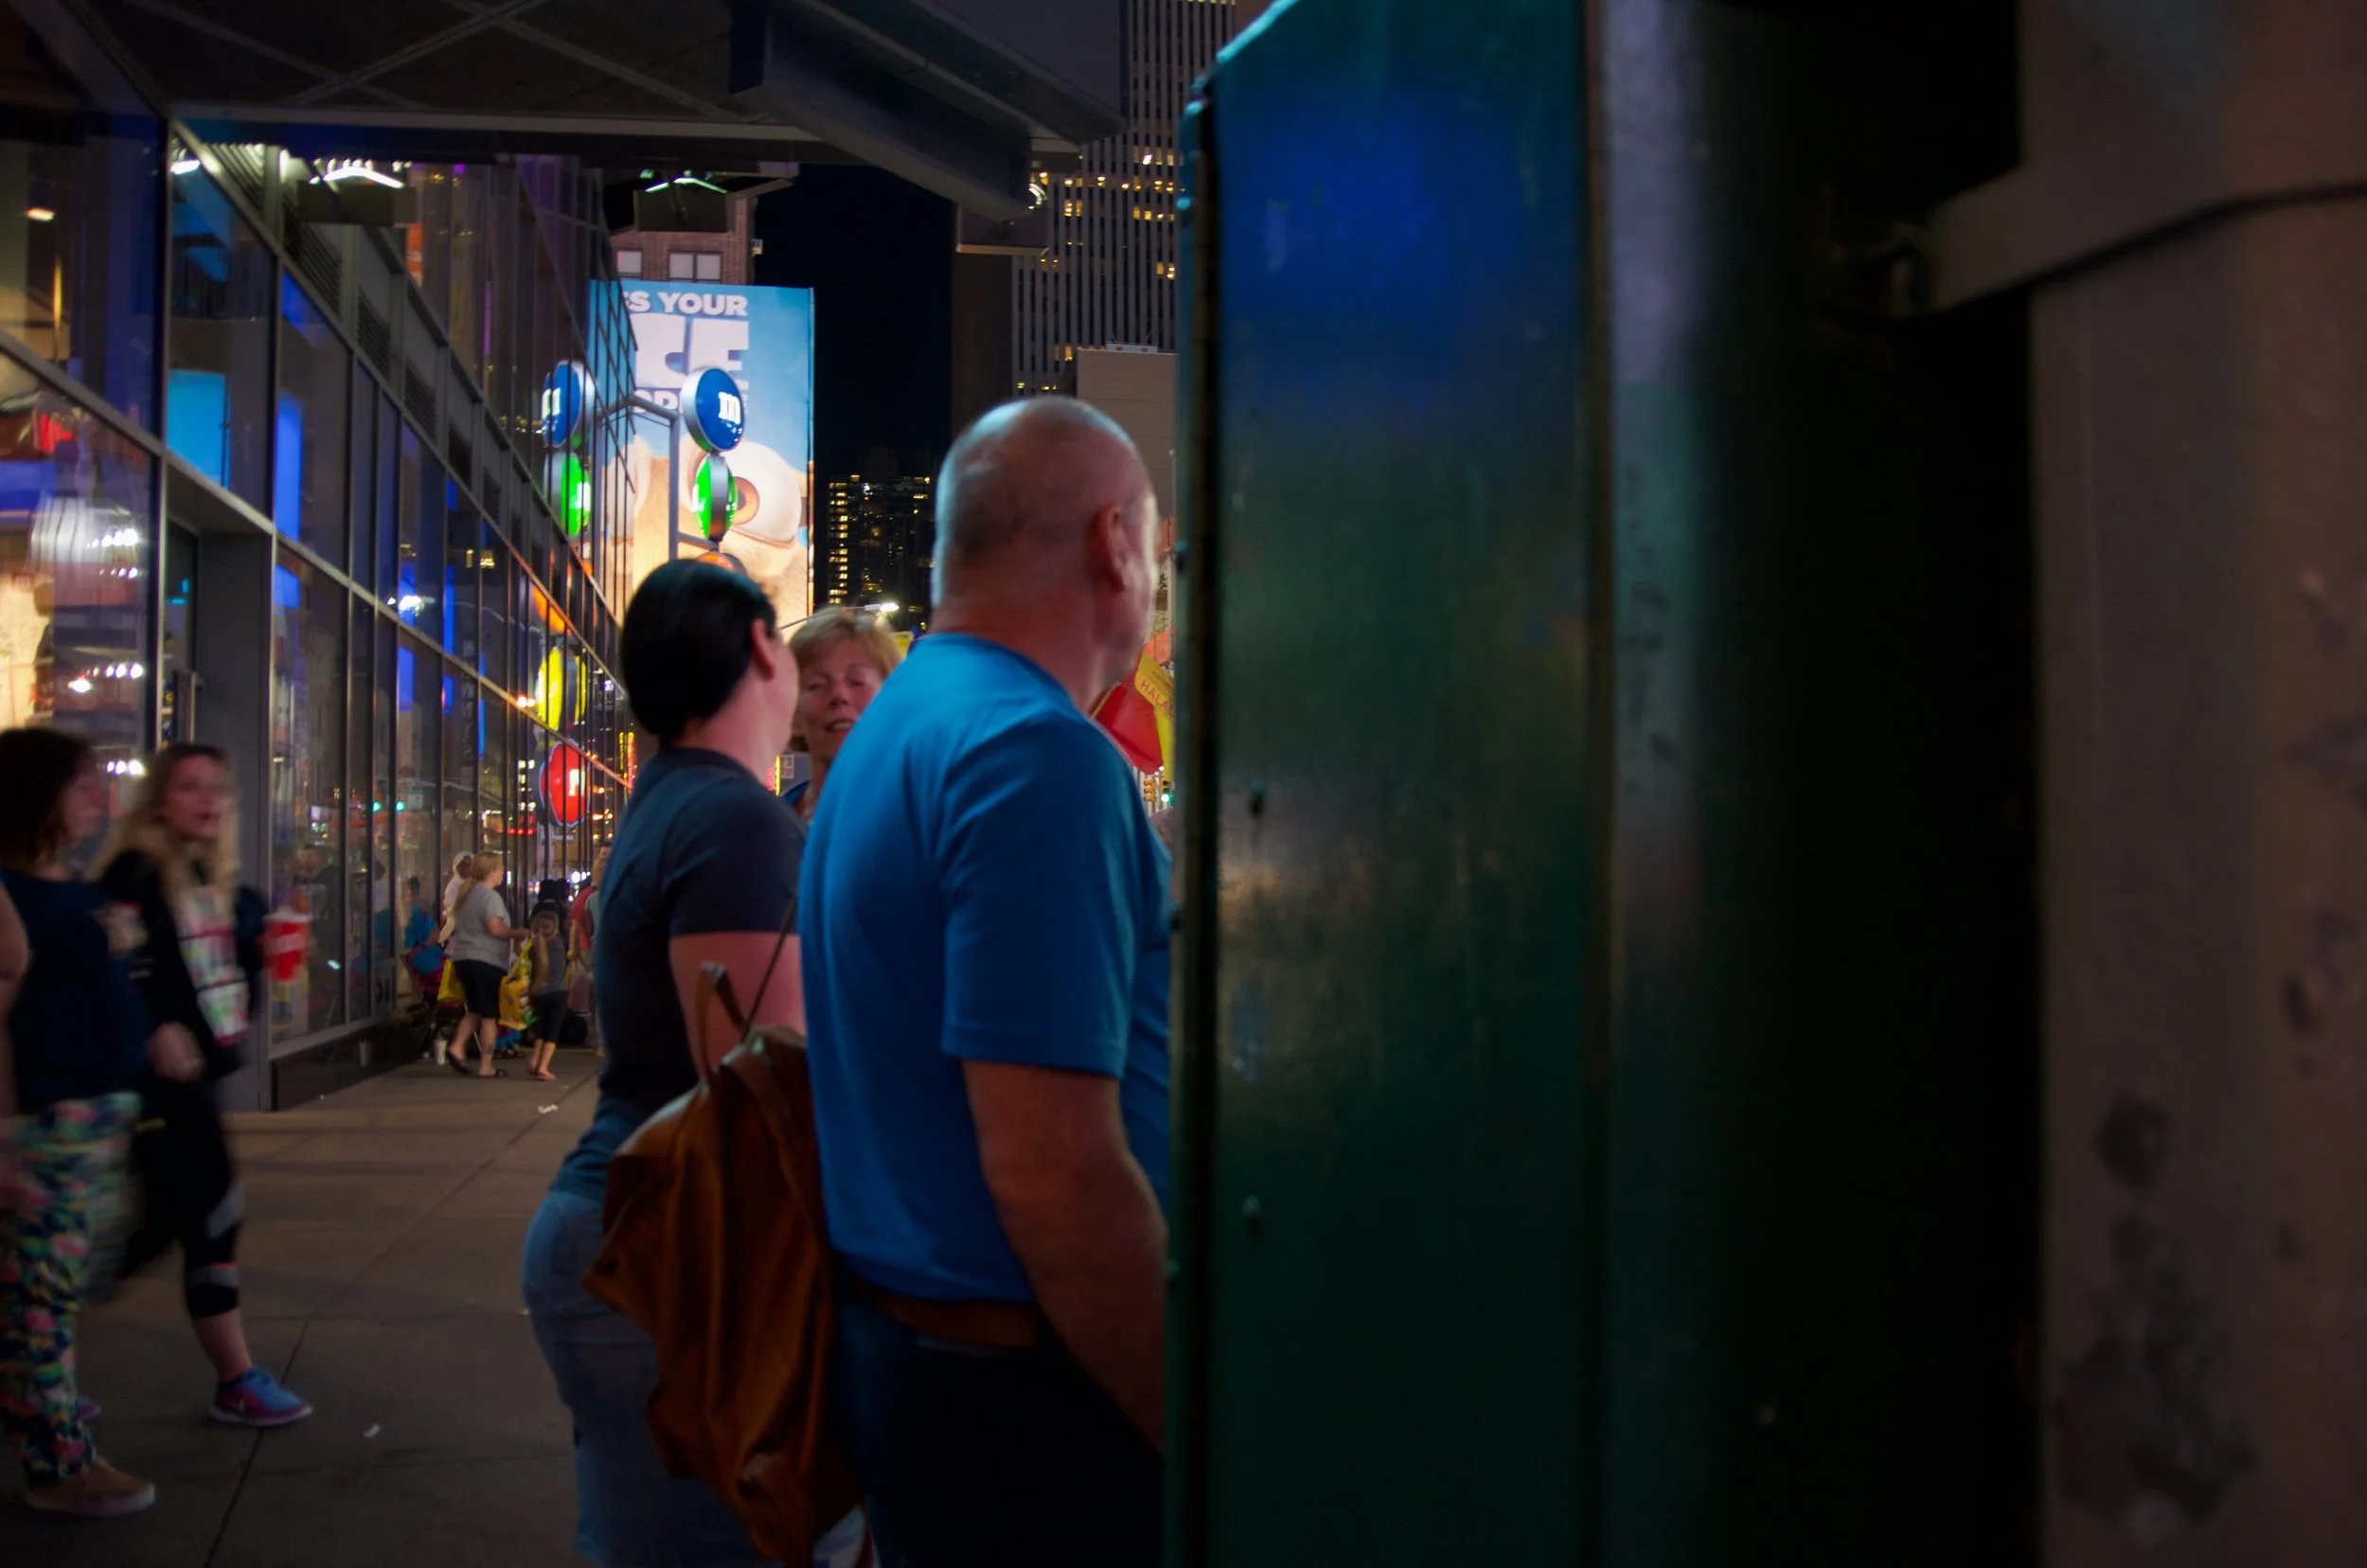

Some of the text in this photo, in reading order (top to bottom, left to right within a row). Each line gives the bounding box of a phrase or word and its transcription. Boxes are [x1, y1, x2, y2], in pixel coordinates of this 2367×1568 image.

[624, 291, 748, 316] S YOUR
[718, 391, 741, 425] m
